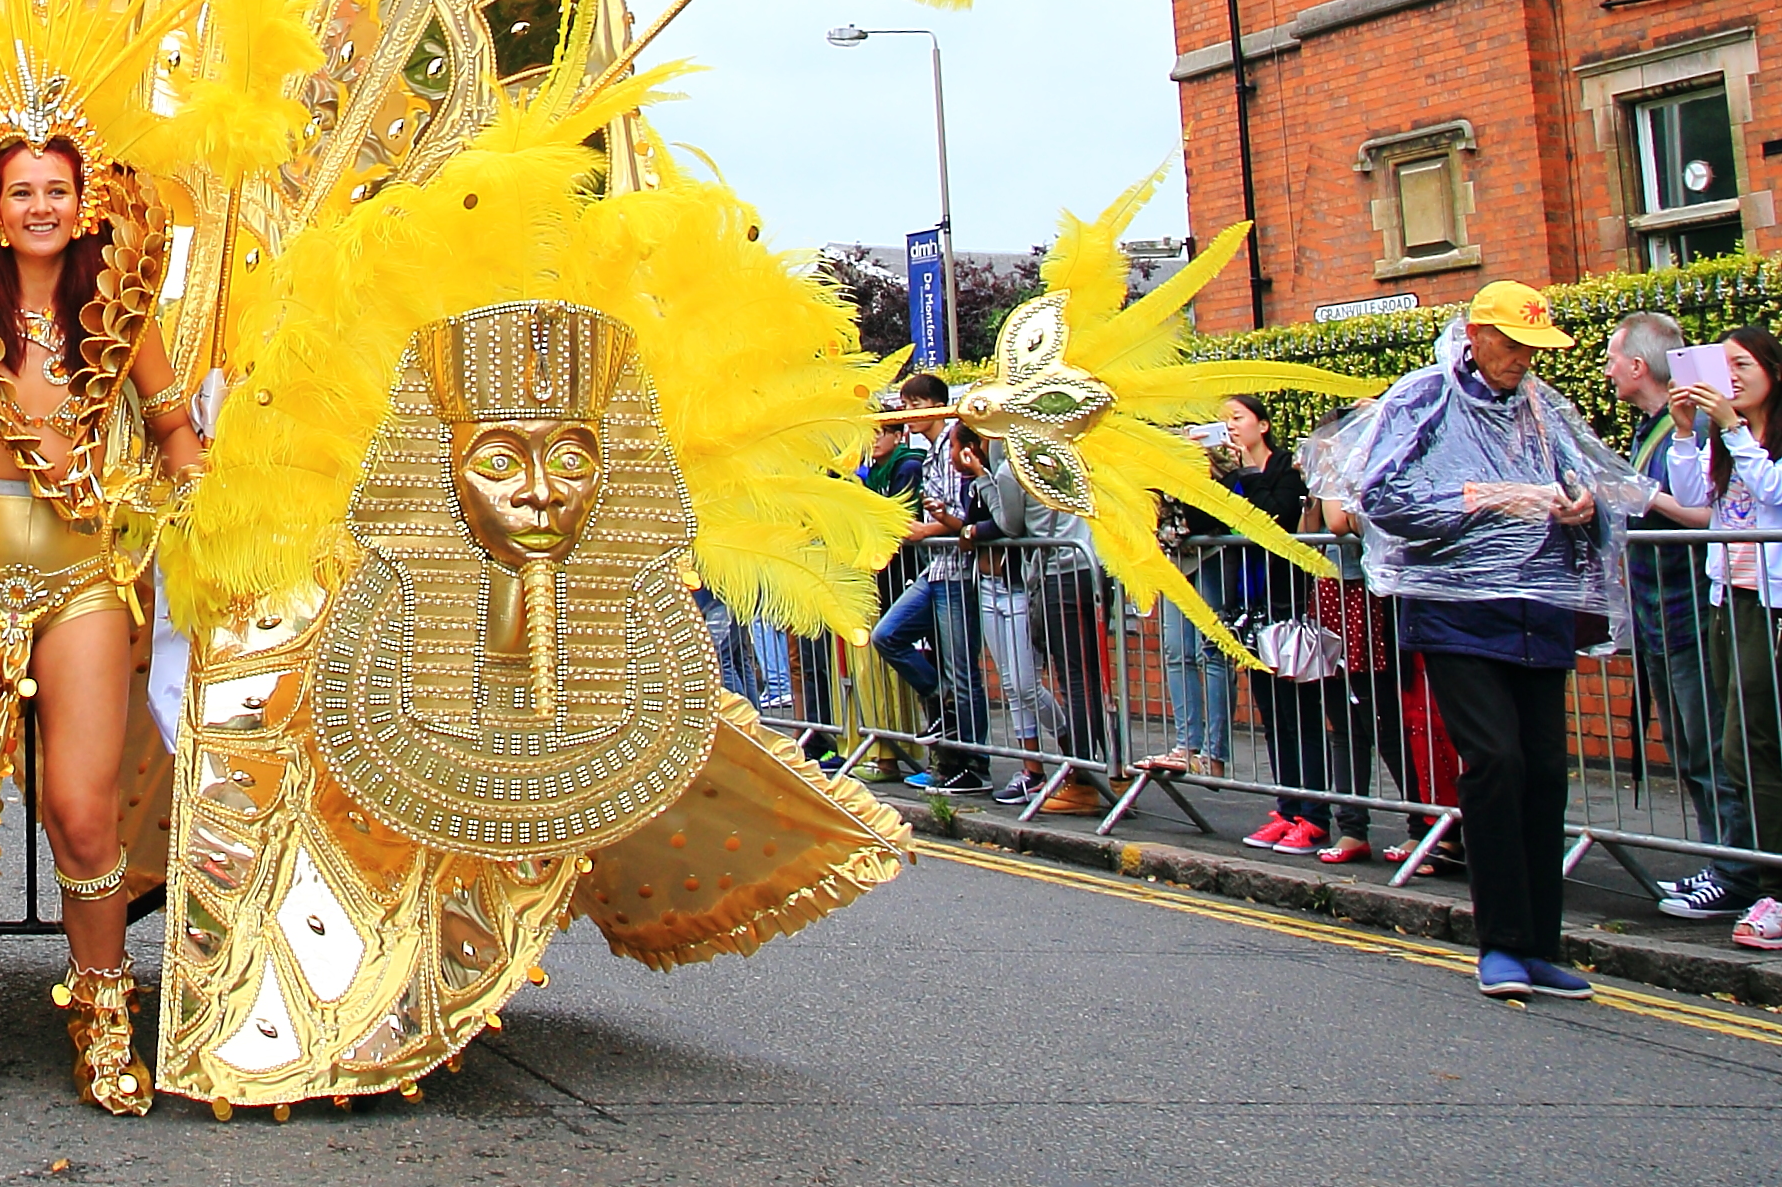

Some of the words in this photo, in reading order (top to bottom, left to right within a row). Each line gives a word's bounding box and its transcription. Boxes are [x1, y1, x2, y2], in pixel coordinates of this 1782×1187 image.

[910, 239, 937, 257] dmh
[924, 273, 932, 290] De
[1321, 302, 1376, 320] GRANVILLE
[1382, 297, 1411, 312] ROAD
[925, 293, 935, 347] Montfort
